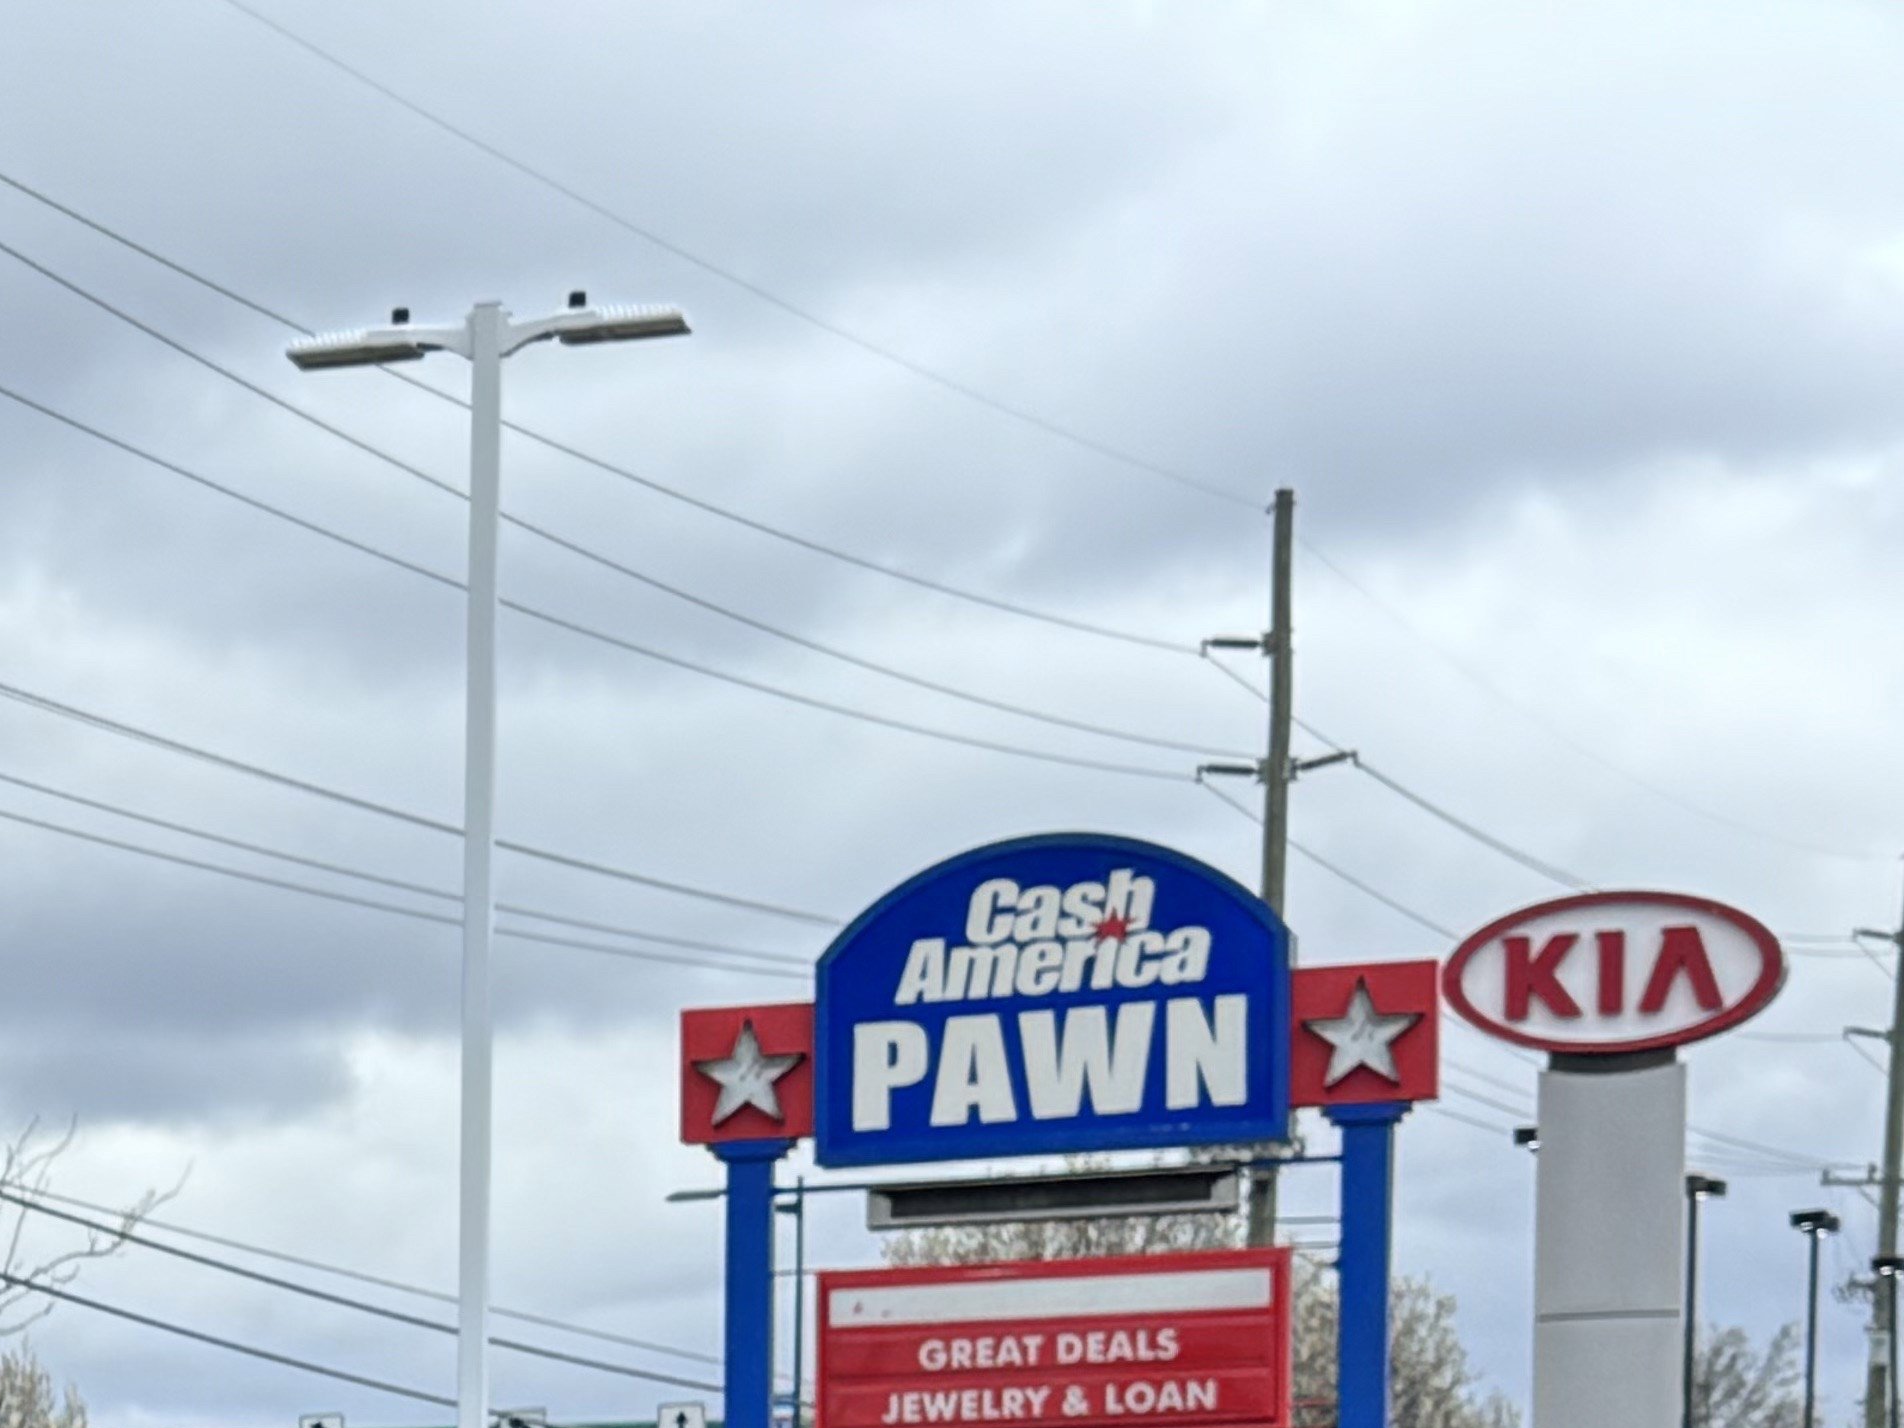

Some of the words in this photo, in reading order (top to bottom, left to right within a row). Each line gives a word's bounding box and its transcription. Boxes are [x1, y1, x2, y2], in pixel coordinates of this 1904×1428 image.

[965, 868, 1156, 944] Cash
[894, 925, 1212, 1006] America
[1502, 925, 1723, 1022] KIA
[852, 993, 1248, 1132] PAWN
[918, 1333, 1042, 1371] GREAT
[1056, 1328, 1179, 1365] DEALS
[882, 1385, 1051, 1426] JEWELRY
[1061, 1384, 1088, 1417] &
[1105, 1378, 1217, 1415] LOAN
